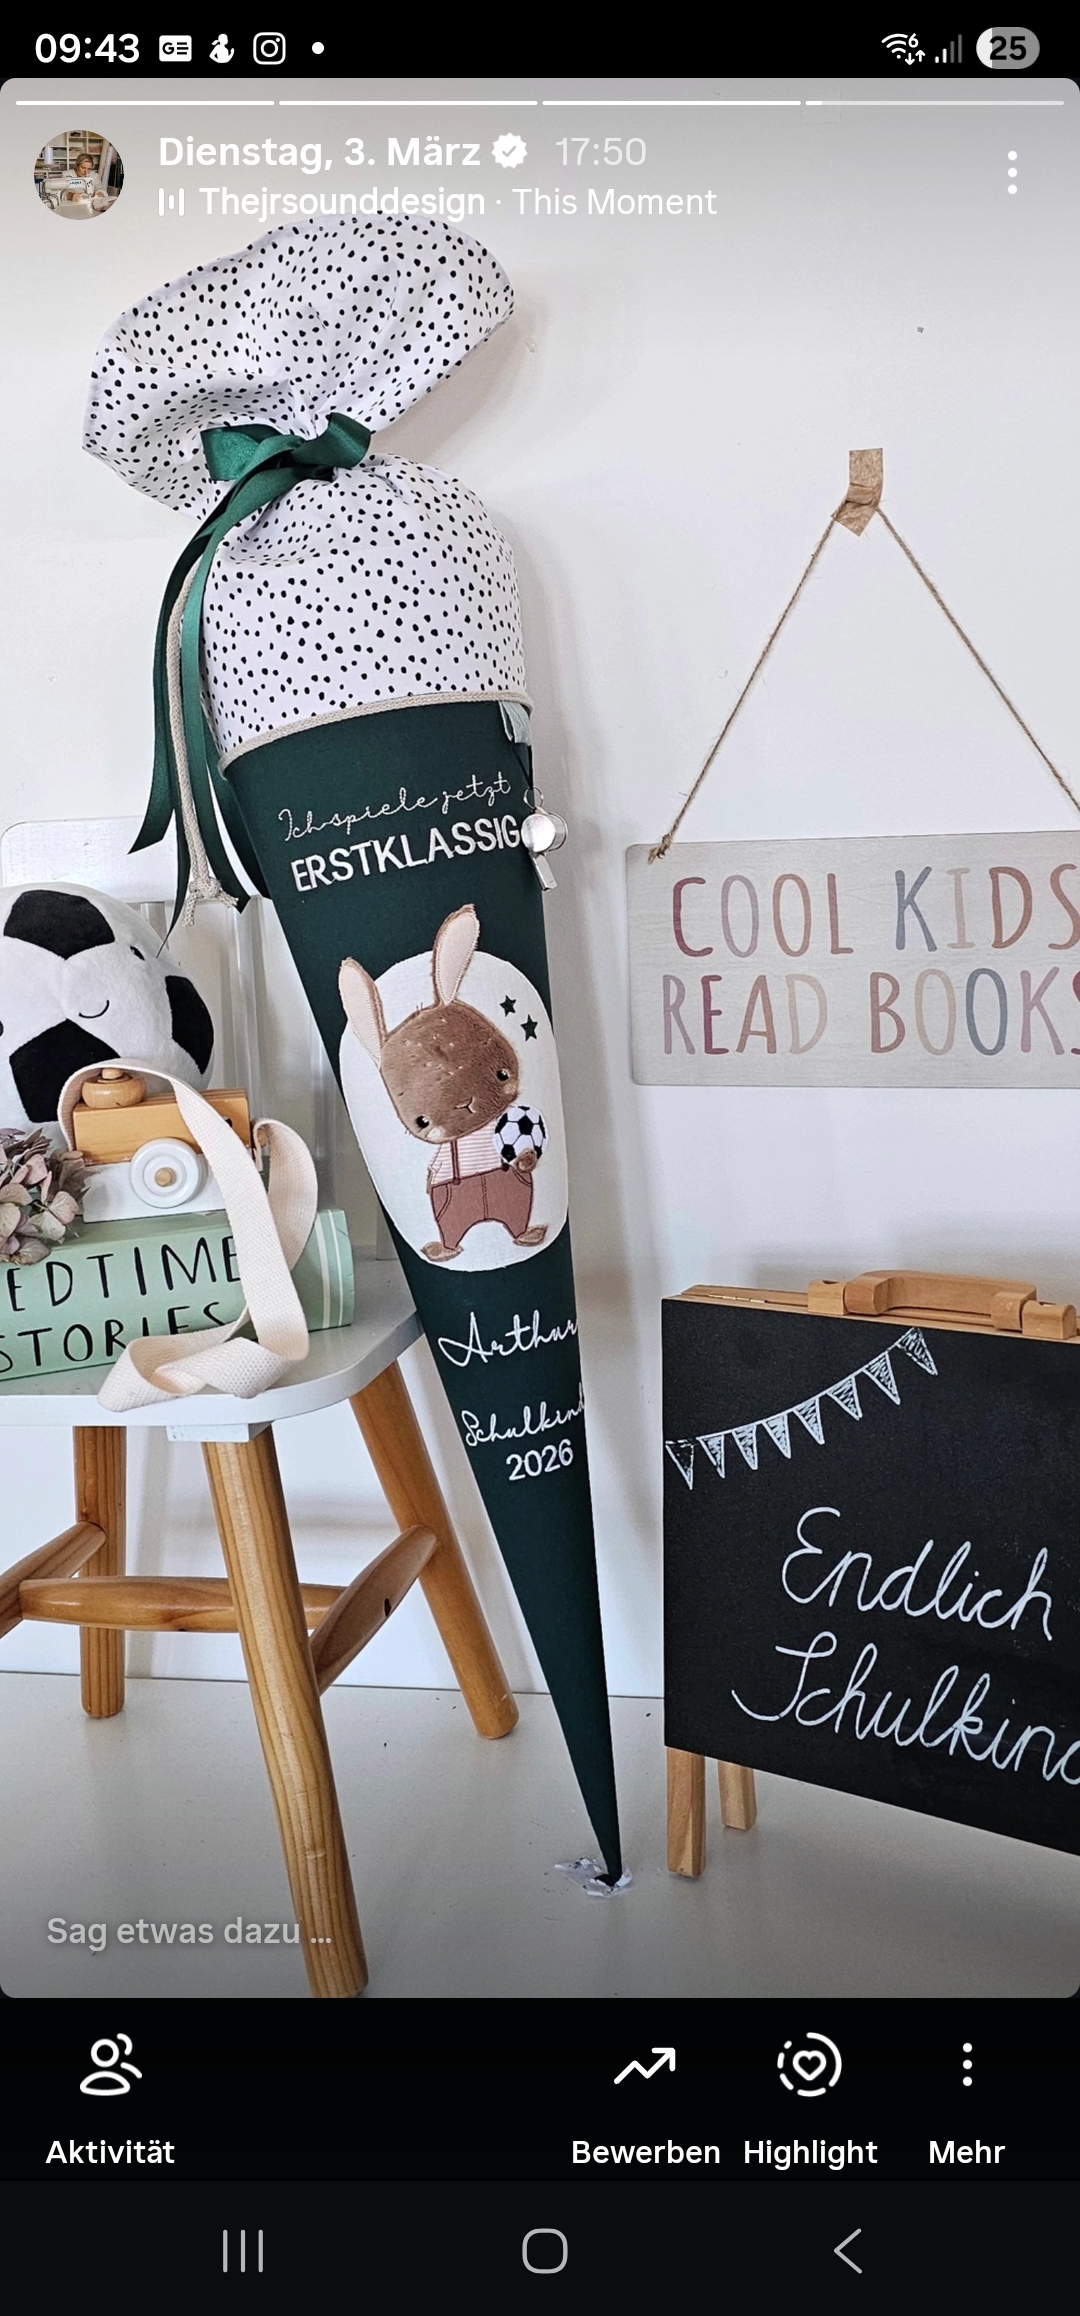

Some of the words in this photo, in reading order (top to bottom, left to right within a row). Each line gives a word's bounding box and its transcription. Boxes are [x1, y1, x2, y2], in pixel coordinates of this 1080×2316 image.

[277, 808, 325, 842] Ich
[440, 770, 512, 815] jetzt
[290, 814, 522, 892] ERSTKLASSIG
[672, 872, 855, 958] COOL
[894, 862, 1080, 953] KIDS
[661, 973, 828, 1056] READ
[437, 1309, 579, 1368] Arthur
[505, 1438, 575, 1482] 2026
[781, 1506, 1053, 1642] Endlich
